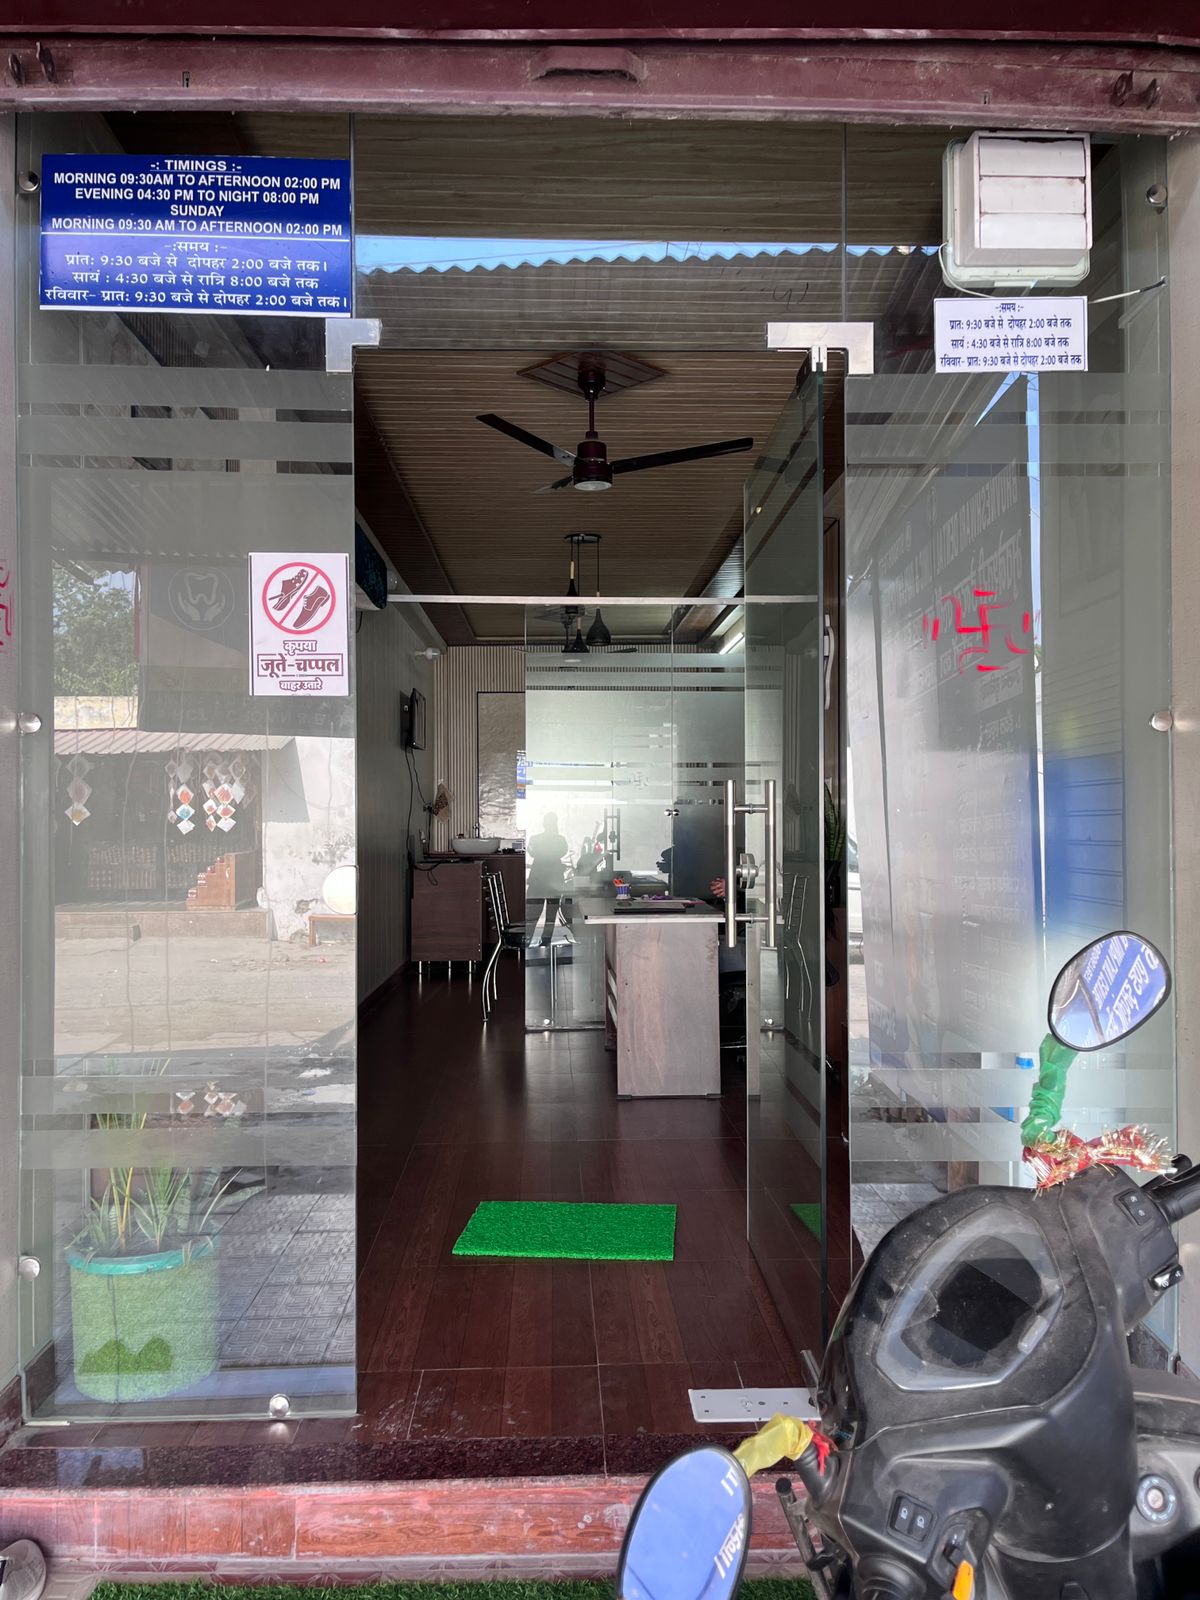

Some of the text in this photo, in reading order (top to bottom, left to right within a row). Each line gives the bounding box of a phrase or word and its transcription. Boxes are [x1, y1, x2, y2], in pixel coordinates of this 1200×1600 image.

[165, 159, 227, 171] TIMINGS
[54, 173, 340, 189] MORNING 09:30AM TO AFTERNOON 02:00 PM
[75, 189, 319, 204] EVENING 04:30 PM TO NIGHT 08:00 PM
[170, 205, 224, 217] SUNDAY
[52, 218, 342, 236] MORNING 09:30 AM TO AFTERNOON 02:00 PM
[65, 254, 94, 266] प्रात:
[100, 256, 132, 266] 9:30
[138, 253, 161, 267] बजे
[166, 254, 177, 267] से
[187, 256, 225, 270] दोपहर
[232, 258, 264, 270] 2:00
[268, 257, 291, 270] बजे
[73, 269, 100, 283] सायं
[115, 273, 148, 284] 4:30
[154, 271, 177, 285] बजे
[181, 271, 193, 285] से
[198, 271, 225, 286] रात्रि
[231, 276, 262, 287] 8:00
[268, 274, 291, 288] बजे
[296, 277, 318, 289] तक
[101, 290, 129, 302] प्रात:
[135, 291, 166, 303] 9:30
[171, 288, 193, 304] बजे
[198, 289, 209, 304] से
[214, 290, 251, 306] दोपहर
[256, 294, 286, 306] 2:00
[292, 292, 314, 307] बजे
[950, 315, 1072, 330] प्रात: 9:30 बजे से दोपहर 2:00 बजे तक
[951, 336, 964, 349] सायं
[971, 339, 987, 349] 4:30
[990, 335, 1001, 348] बजे
[1003, 336, 1008, 348] से
[1011, 335, 1024, 348] रात्रि
[1026, 338, 1042, 348] 8:00
[1045, 334, 1055, 347] बजे
[1057, 337, 1069, 347] तक
[967, 356, 981, 367] प्रात:
[983, 356, 998, 366] 9:30
[1000, 353, 1011, 365] बजे
[1013, 353, 1019, 365] से
[1021, 352, 1038, 367] दोपहर
[1041, 355, 1056, 365] 2:00
[1058, 352, 1069, 365] बजे
[1071, 355, 1082, 364] तक
[283, 640, 317, 656] कृपया
[261, 653, 340, 678] जूते-चप्पल
